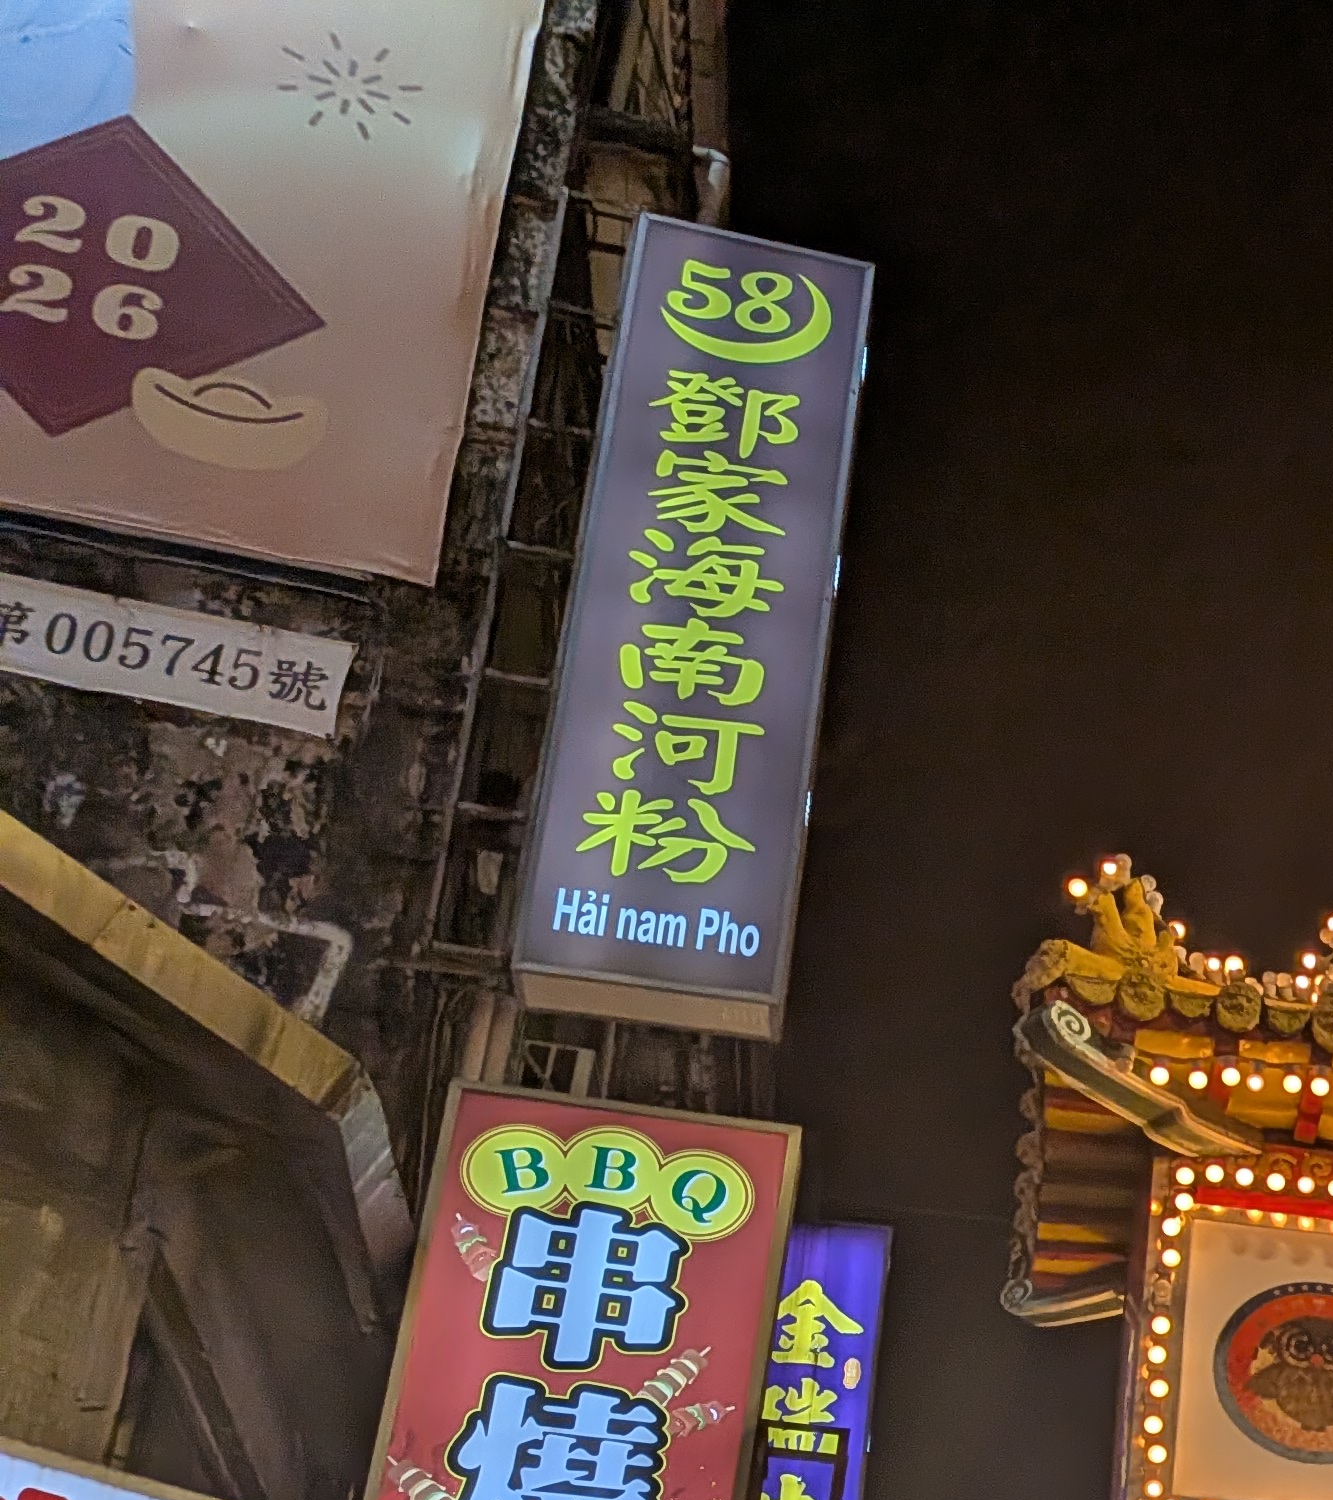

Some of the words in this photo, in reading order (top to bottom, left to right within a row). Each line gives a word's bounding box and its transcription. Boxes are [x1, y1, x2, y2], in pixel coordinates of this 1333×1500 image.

[14, 195, 181, 272] 20
[0, 264, 163, 341] 26
[664, 258, 798, 336] 58
[576, 369, 800, 884] 鄧家海南河粉
[552, 887, 609, 938] Hải
[615, 911, 688, 950] nam
[694, 908, 762, 957] Pho
[496, 1144, 728, 1224] BBQ
